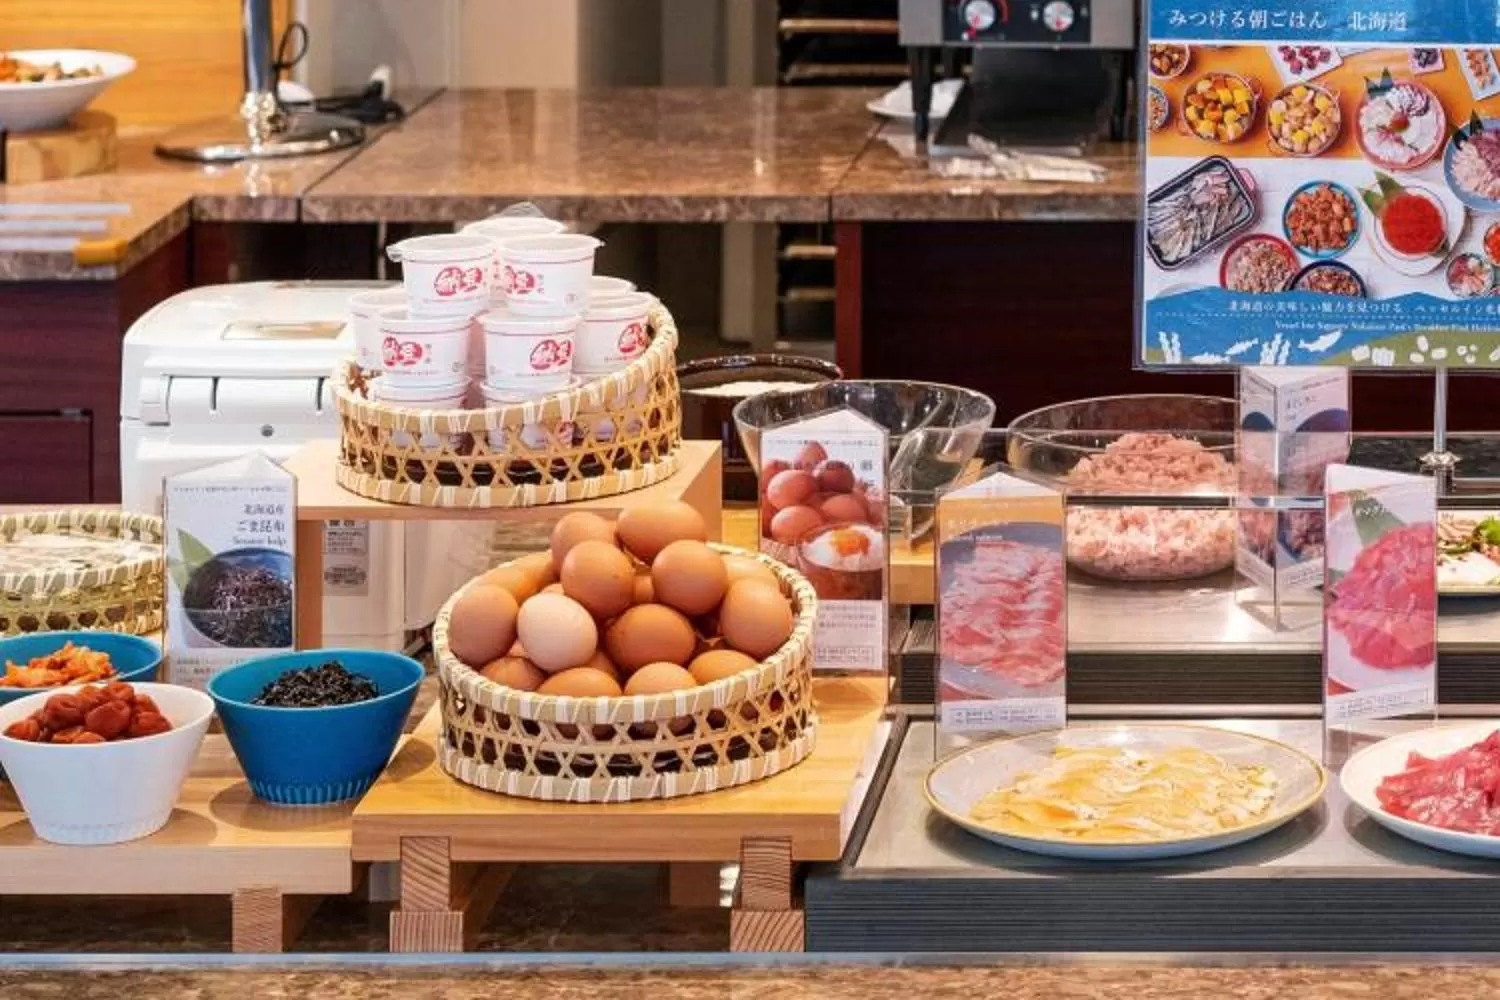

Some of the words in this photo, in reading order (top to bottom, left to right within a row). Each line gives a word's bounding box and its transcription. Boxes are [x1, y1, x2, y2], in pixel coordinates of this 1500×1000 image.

[1168, 8, 1327, 30] みつける朝ごはん
[1347, 10, 1408, 32] 北海道
